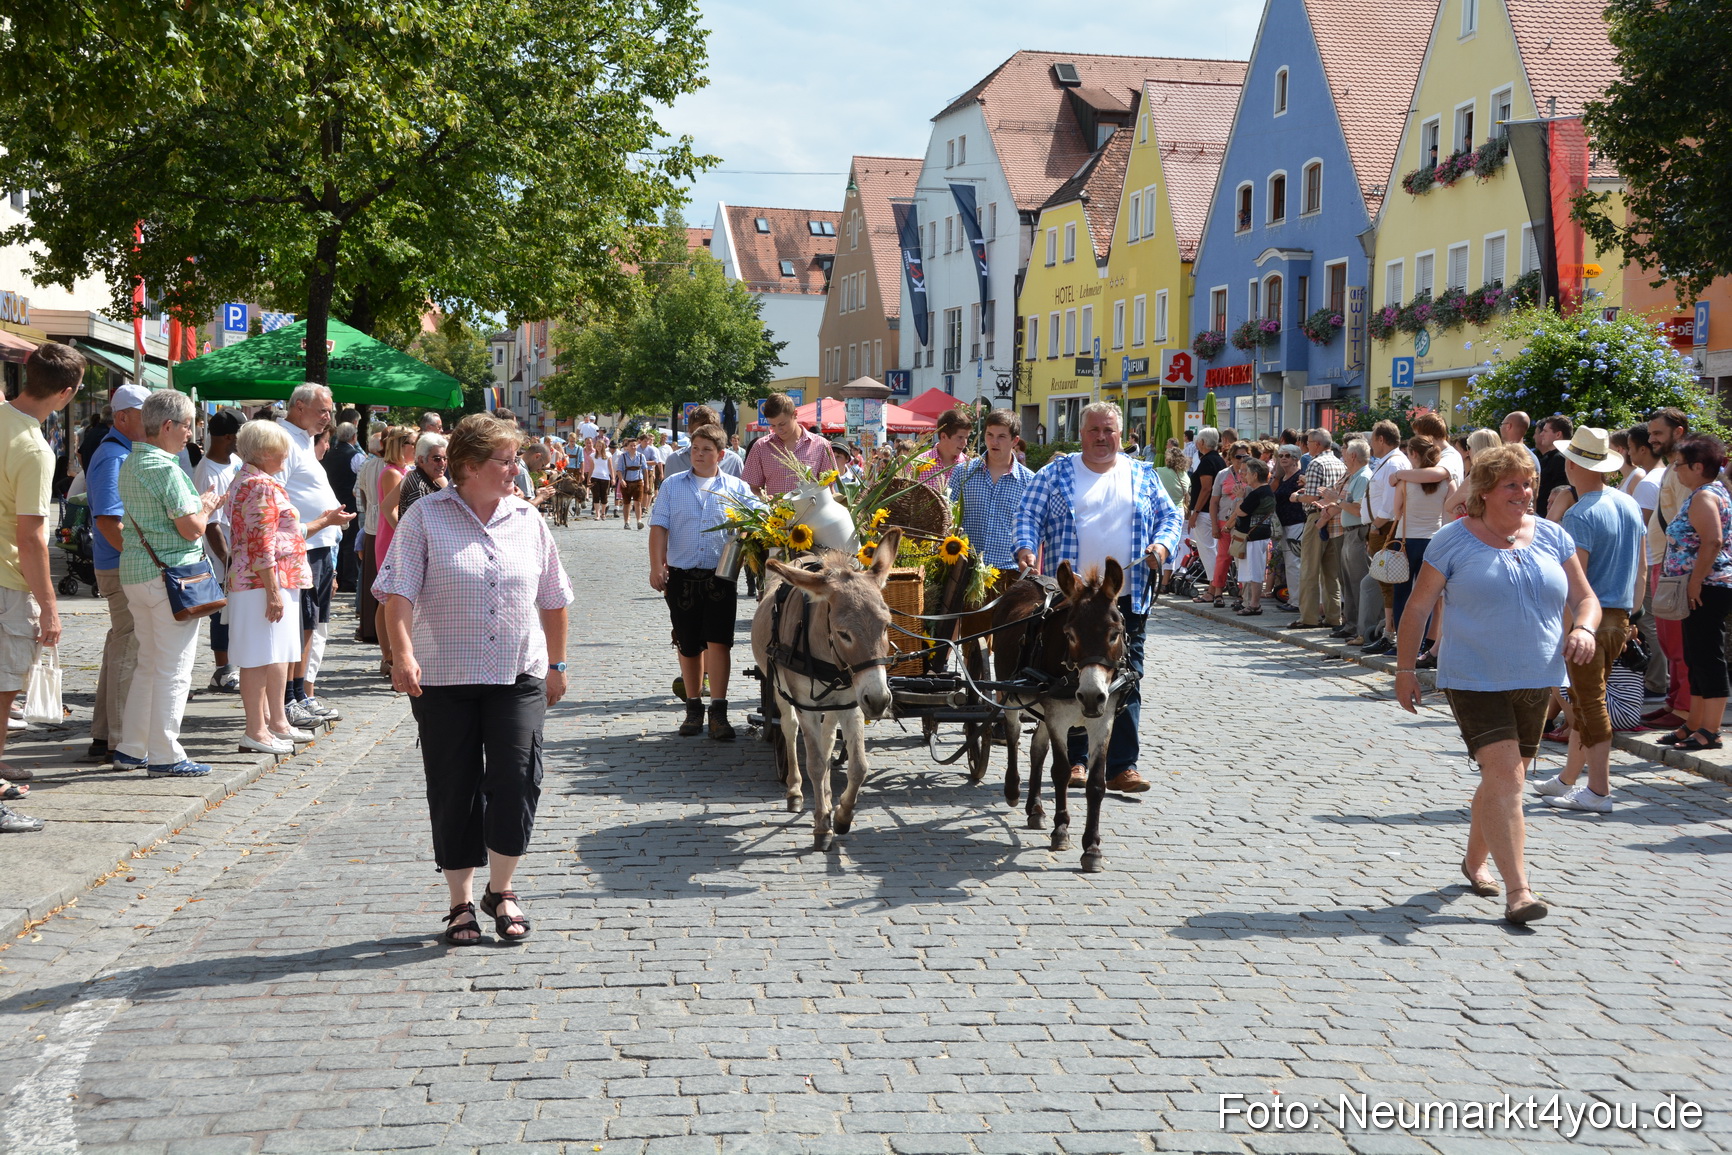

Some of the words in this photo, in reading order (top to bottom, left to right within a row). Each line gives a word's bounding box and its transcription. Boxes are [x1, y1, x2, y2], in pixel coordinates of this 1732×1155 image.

[1054, 285, 1075, 305] HOTEL
[229, 306, 242, 328] P
[1697, 307, 1706, 339] P
[1350, 302, 1363, 364] WITTL
[1127, 360, 1144, 373] AIFUN
[1396, 360, 1410, 385] P
[1050, 378, 1079, 391] Restaurant
